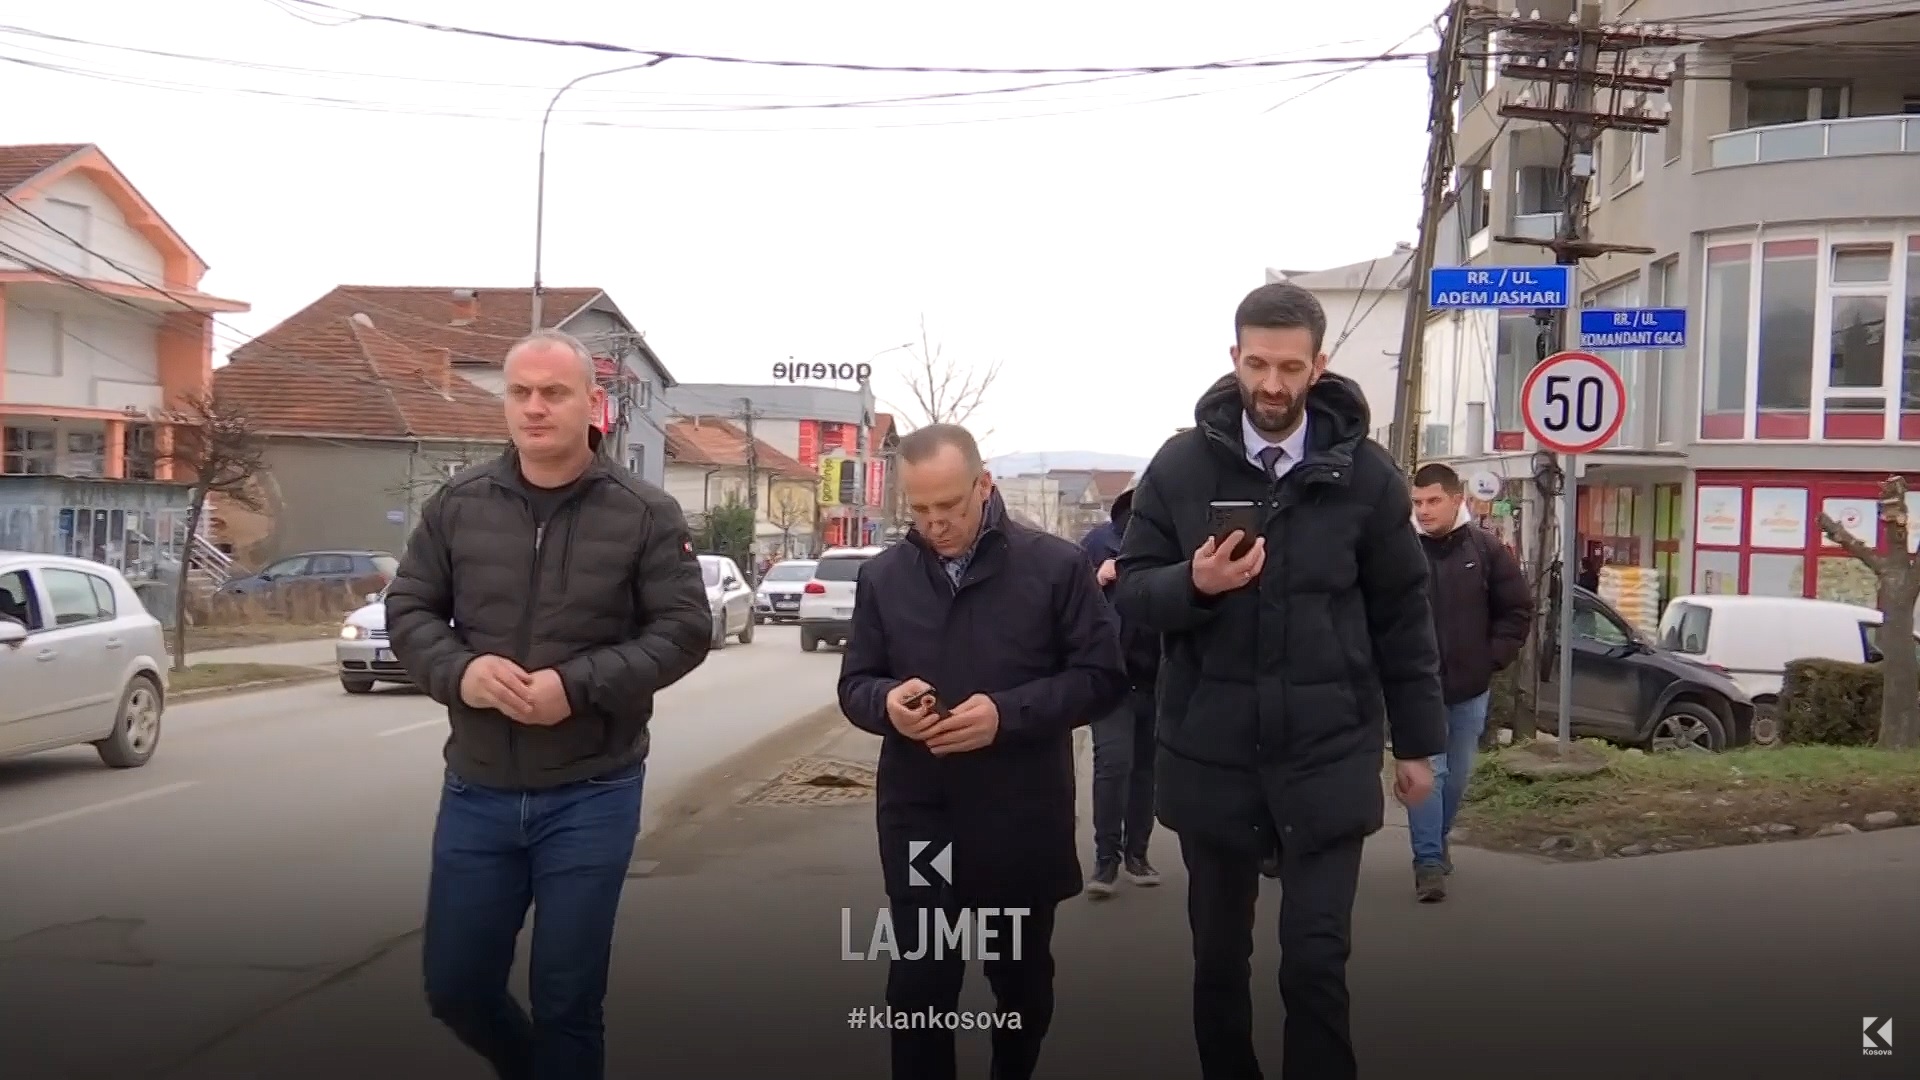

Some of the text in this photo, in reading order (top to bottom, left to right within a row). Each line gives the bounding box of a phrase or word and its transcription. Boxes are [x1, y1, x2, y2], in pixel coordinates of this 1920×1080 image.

[1467, 268, 1539, 288] RR. / UL.
[1437, 291, 1561, 304] ADEM JASHARI
[1633, 310, 1640, 328] /
[1580, 331, 1683, 346] KOMANDANT GACA
[1543, 375, 1604, 432] 50
